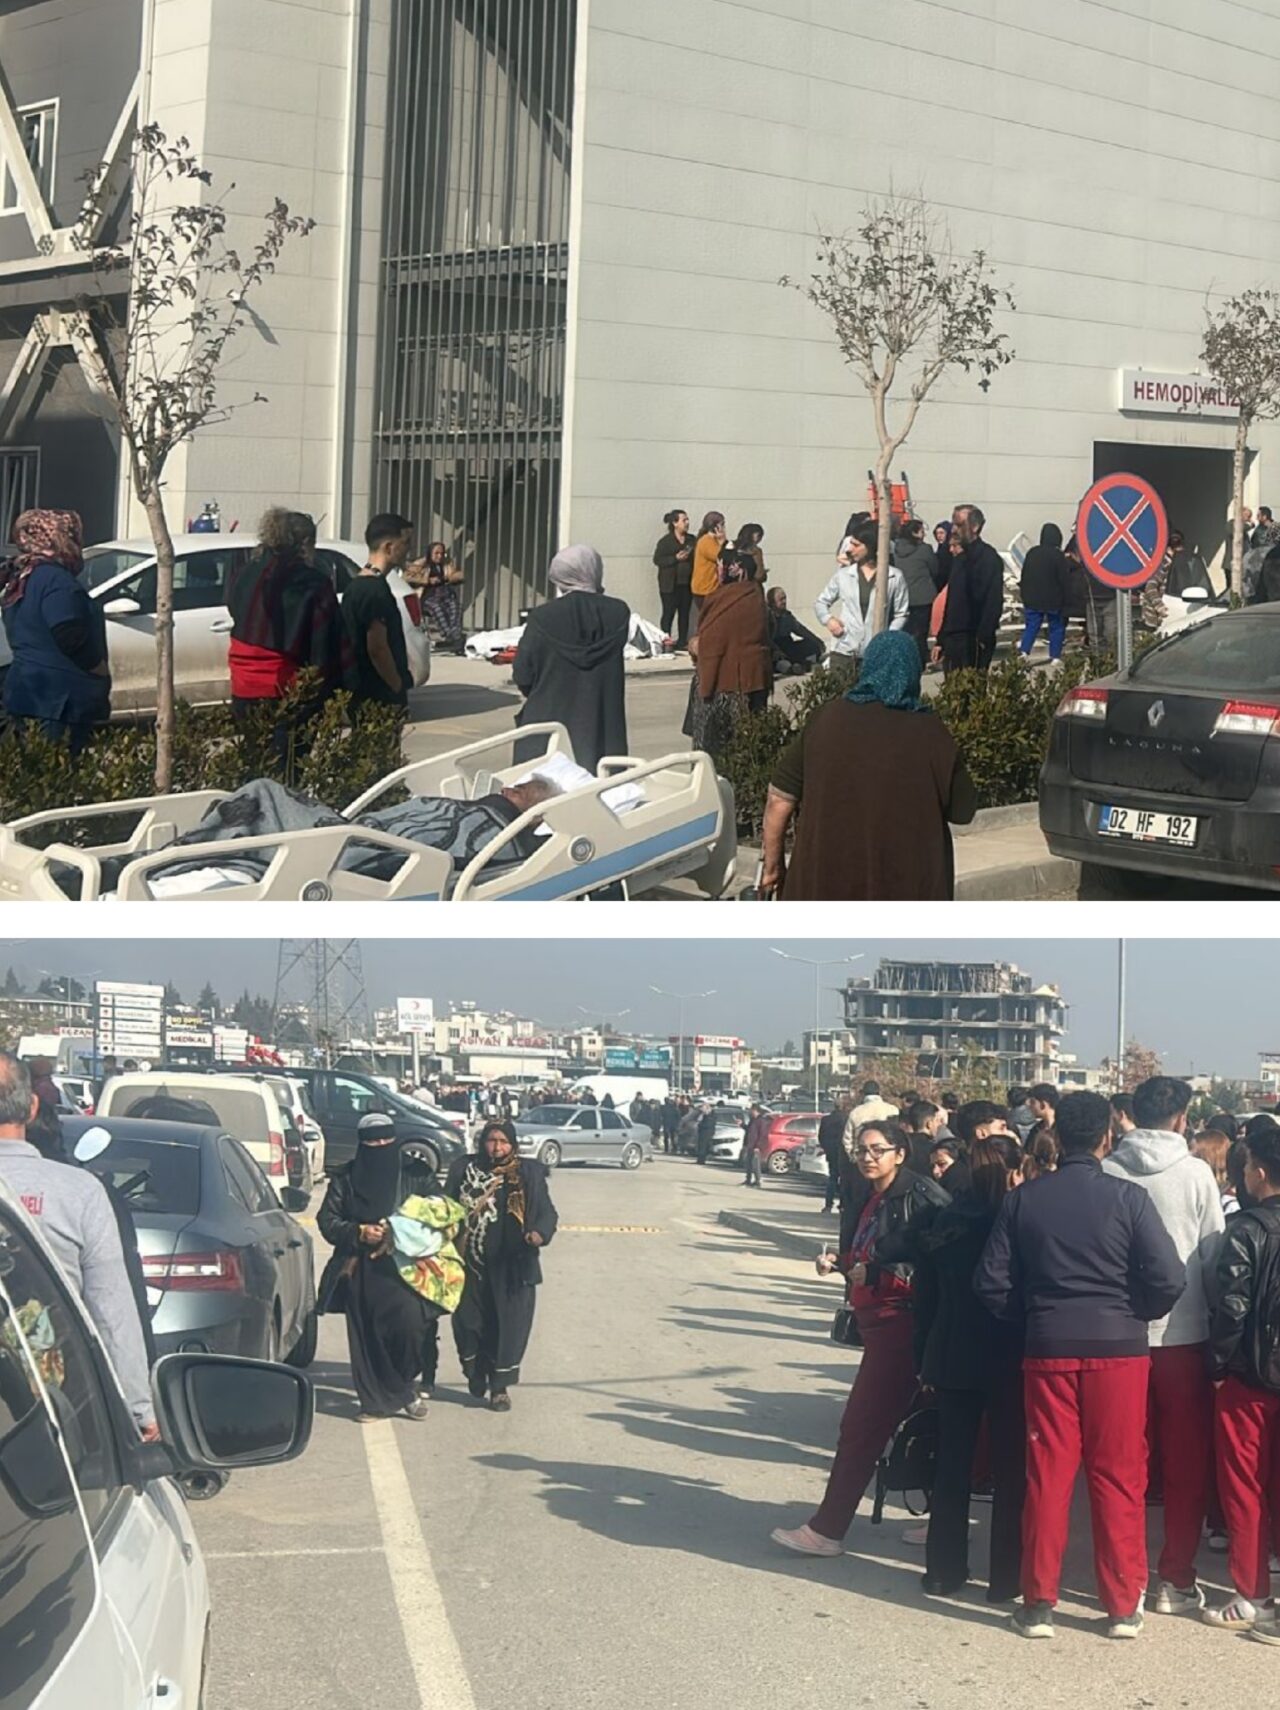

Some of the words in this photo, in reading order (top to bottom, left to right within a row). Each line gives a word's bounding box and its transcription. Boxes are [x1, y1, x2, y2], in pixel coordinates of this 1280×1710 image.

[1109, 738, 1201, 753] LAGUNA
[1110, 809, 1128, 829] 02
[1136, 812, 1155, 832] HF
[1166, 816, 1191, 838] 192
